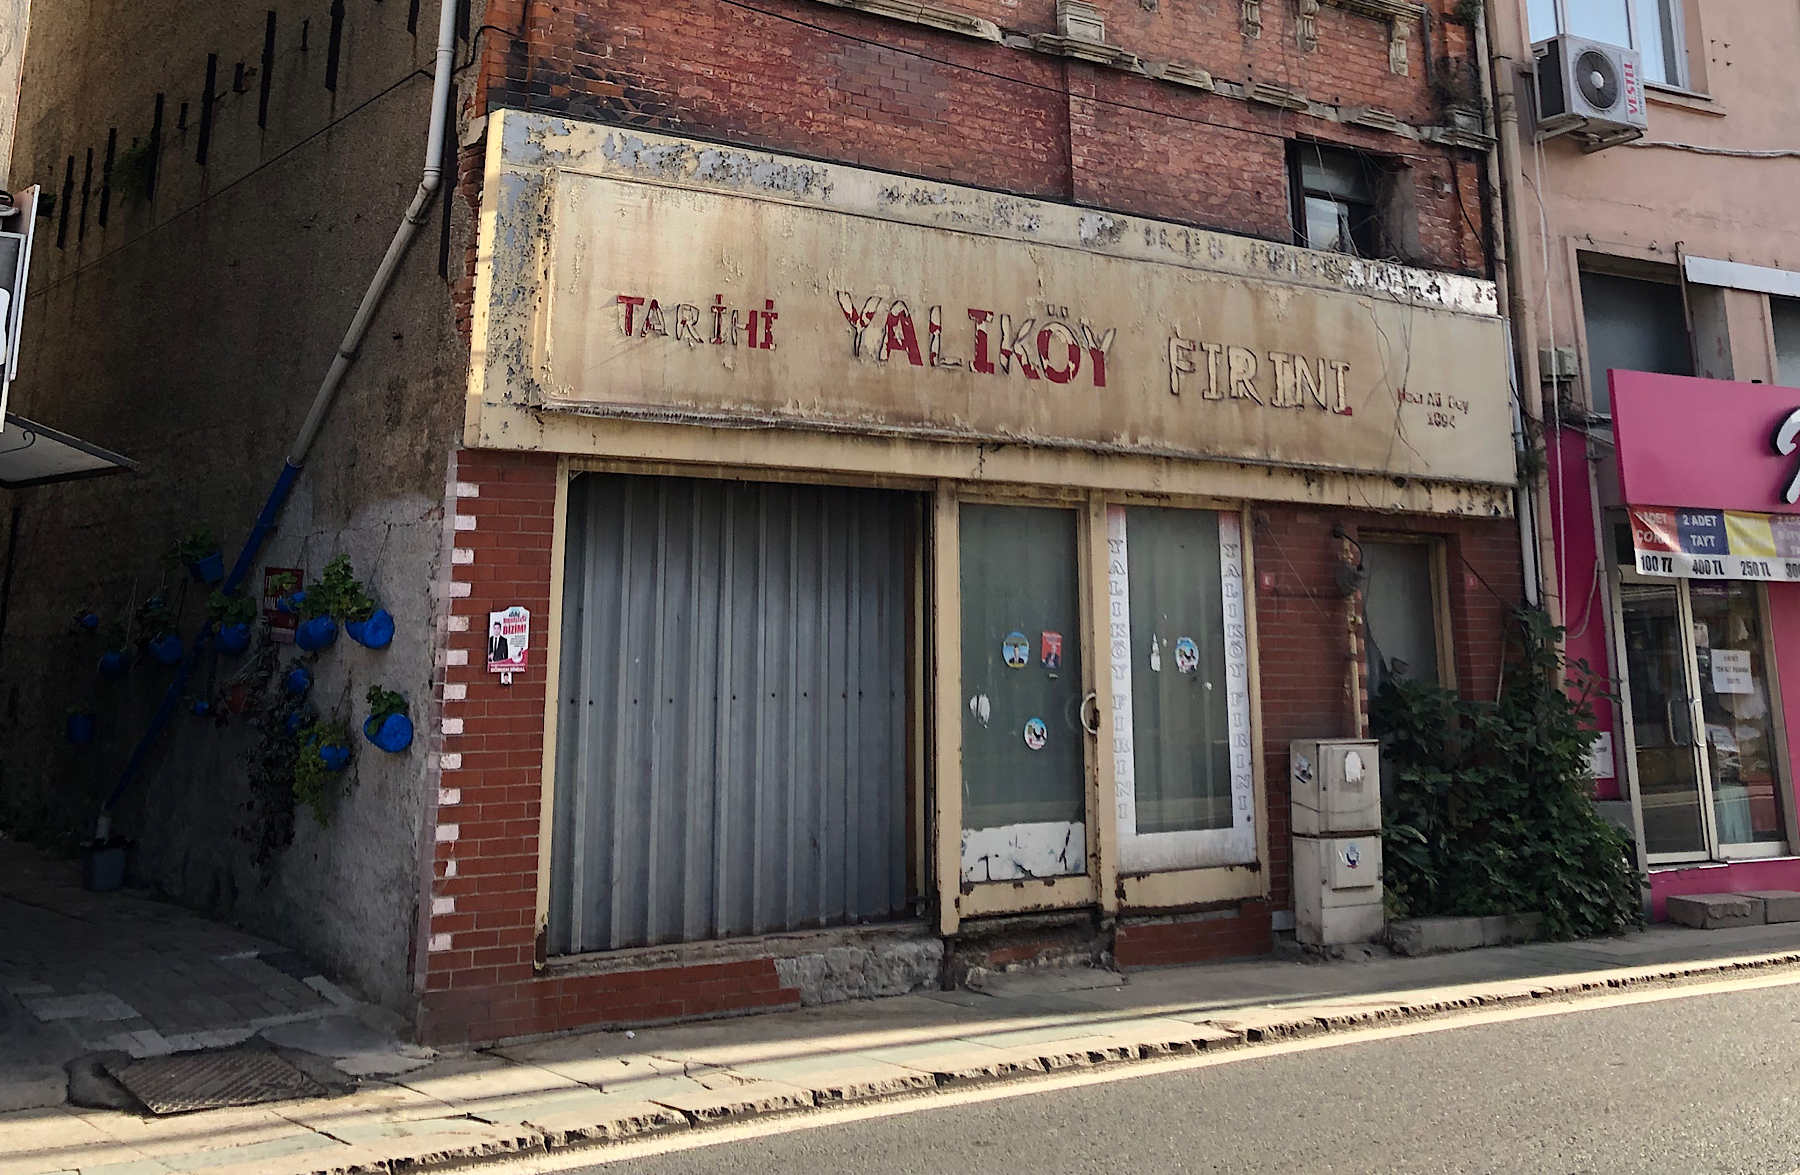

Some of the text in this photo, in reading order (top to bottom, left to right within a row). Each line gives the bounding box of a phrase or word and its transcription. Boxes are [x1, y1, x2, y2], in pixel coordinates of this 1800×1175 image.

[1624, 61, 1638, 114] VESTEL
[615, 290, 1353, 417] TARİHİ YALIKÖY FIRINI
[1682, 514, 1717, 527] 2 ADET
[1690, 534, 1715, 547] TAYT
[1641, 555, 1673, 573] 100 TL
[1692, 559, 1725, 576] 400 TL
[1740, 560, 1771, 577] 250 TL
